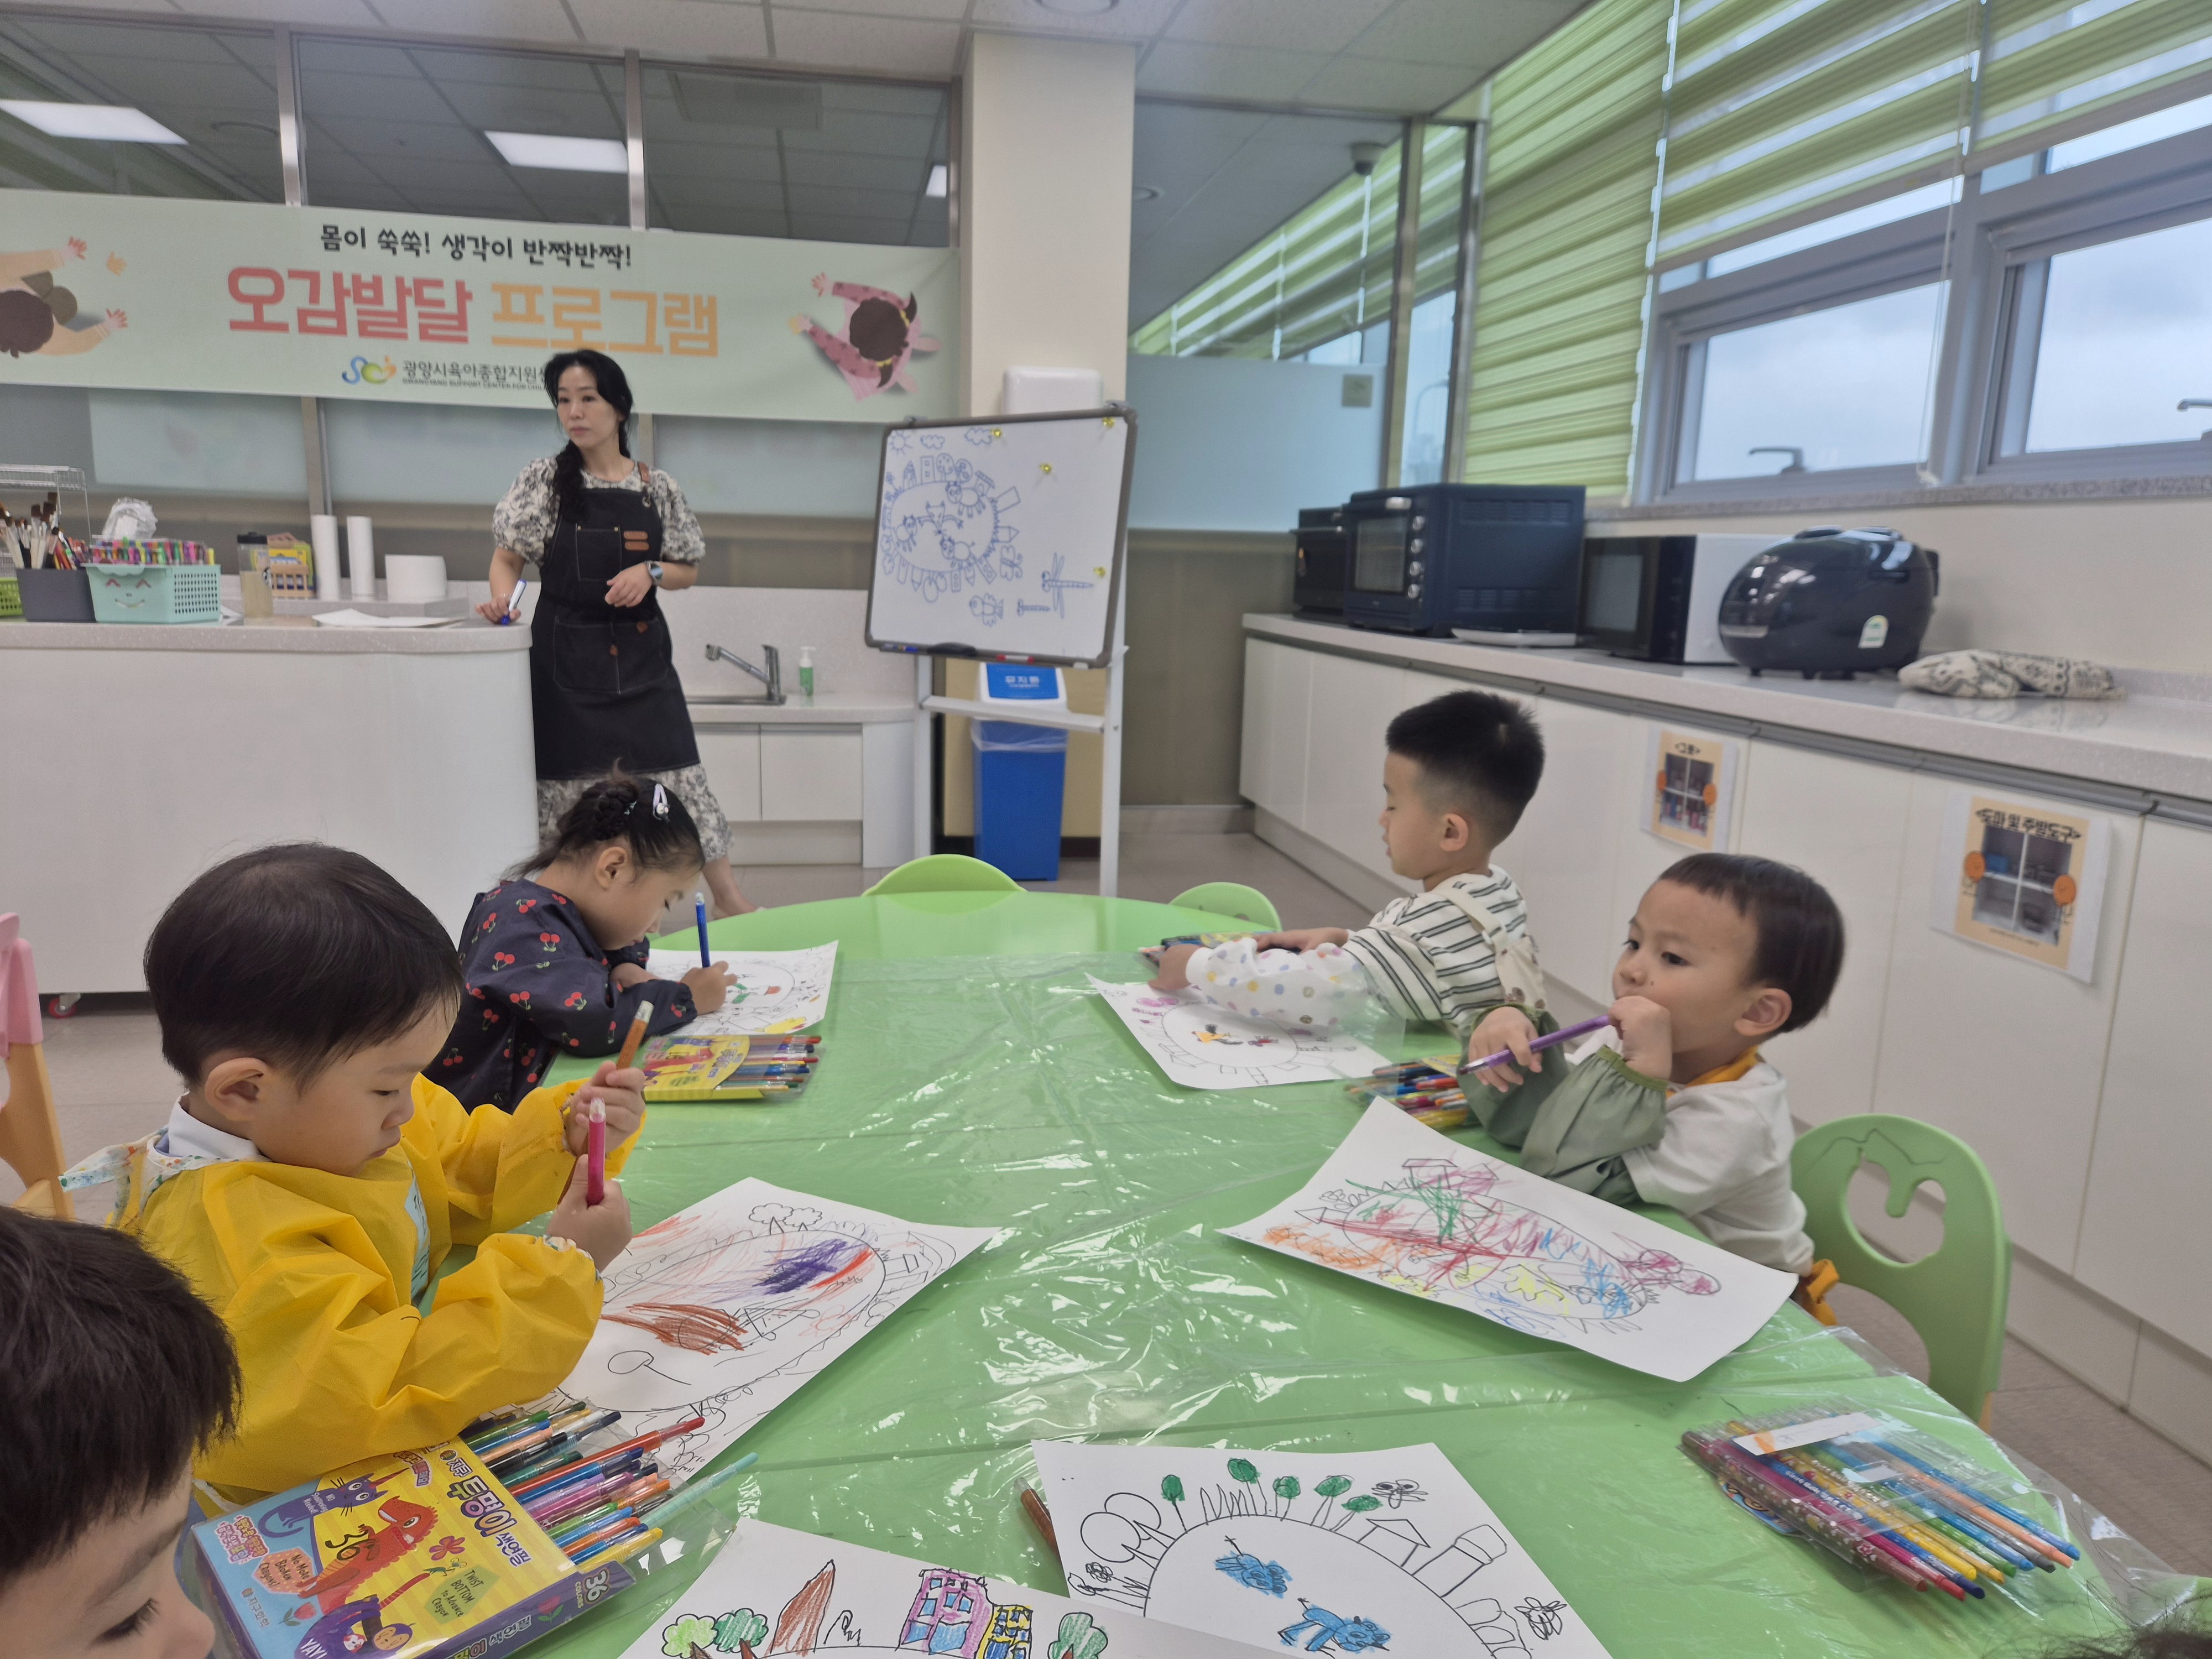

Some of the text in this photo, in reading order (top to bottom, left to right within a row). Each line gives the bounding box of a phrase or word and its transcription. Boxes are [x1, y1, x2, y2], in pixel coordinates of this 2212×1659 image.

[321, 224, 632, 270] 몸이 쑥쑥! 생각이 반짝반짝!
[228, 267, 718, 357] 오감발달 프로그램
[447, 1475, 531, 1567] 투명이 색연필
[451, 1579, 475, 1603] BOTTOM
[464, 1569, 484, 1588] TWIST
[586, 1571, 607, 1601] 36
[489, 1615, 531, 1645] 색연필
